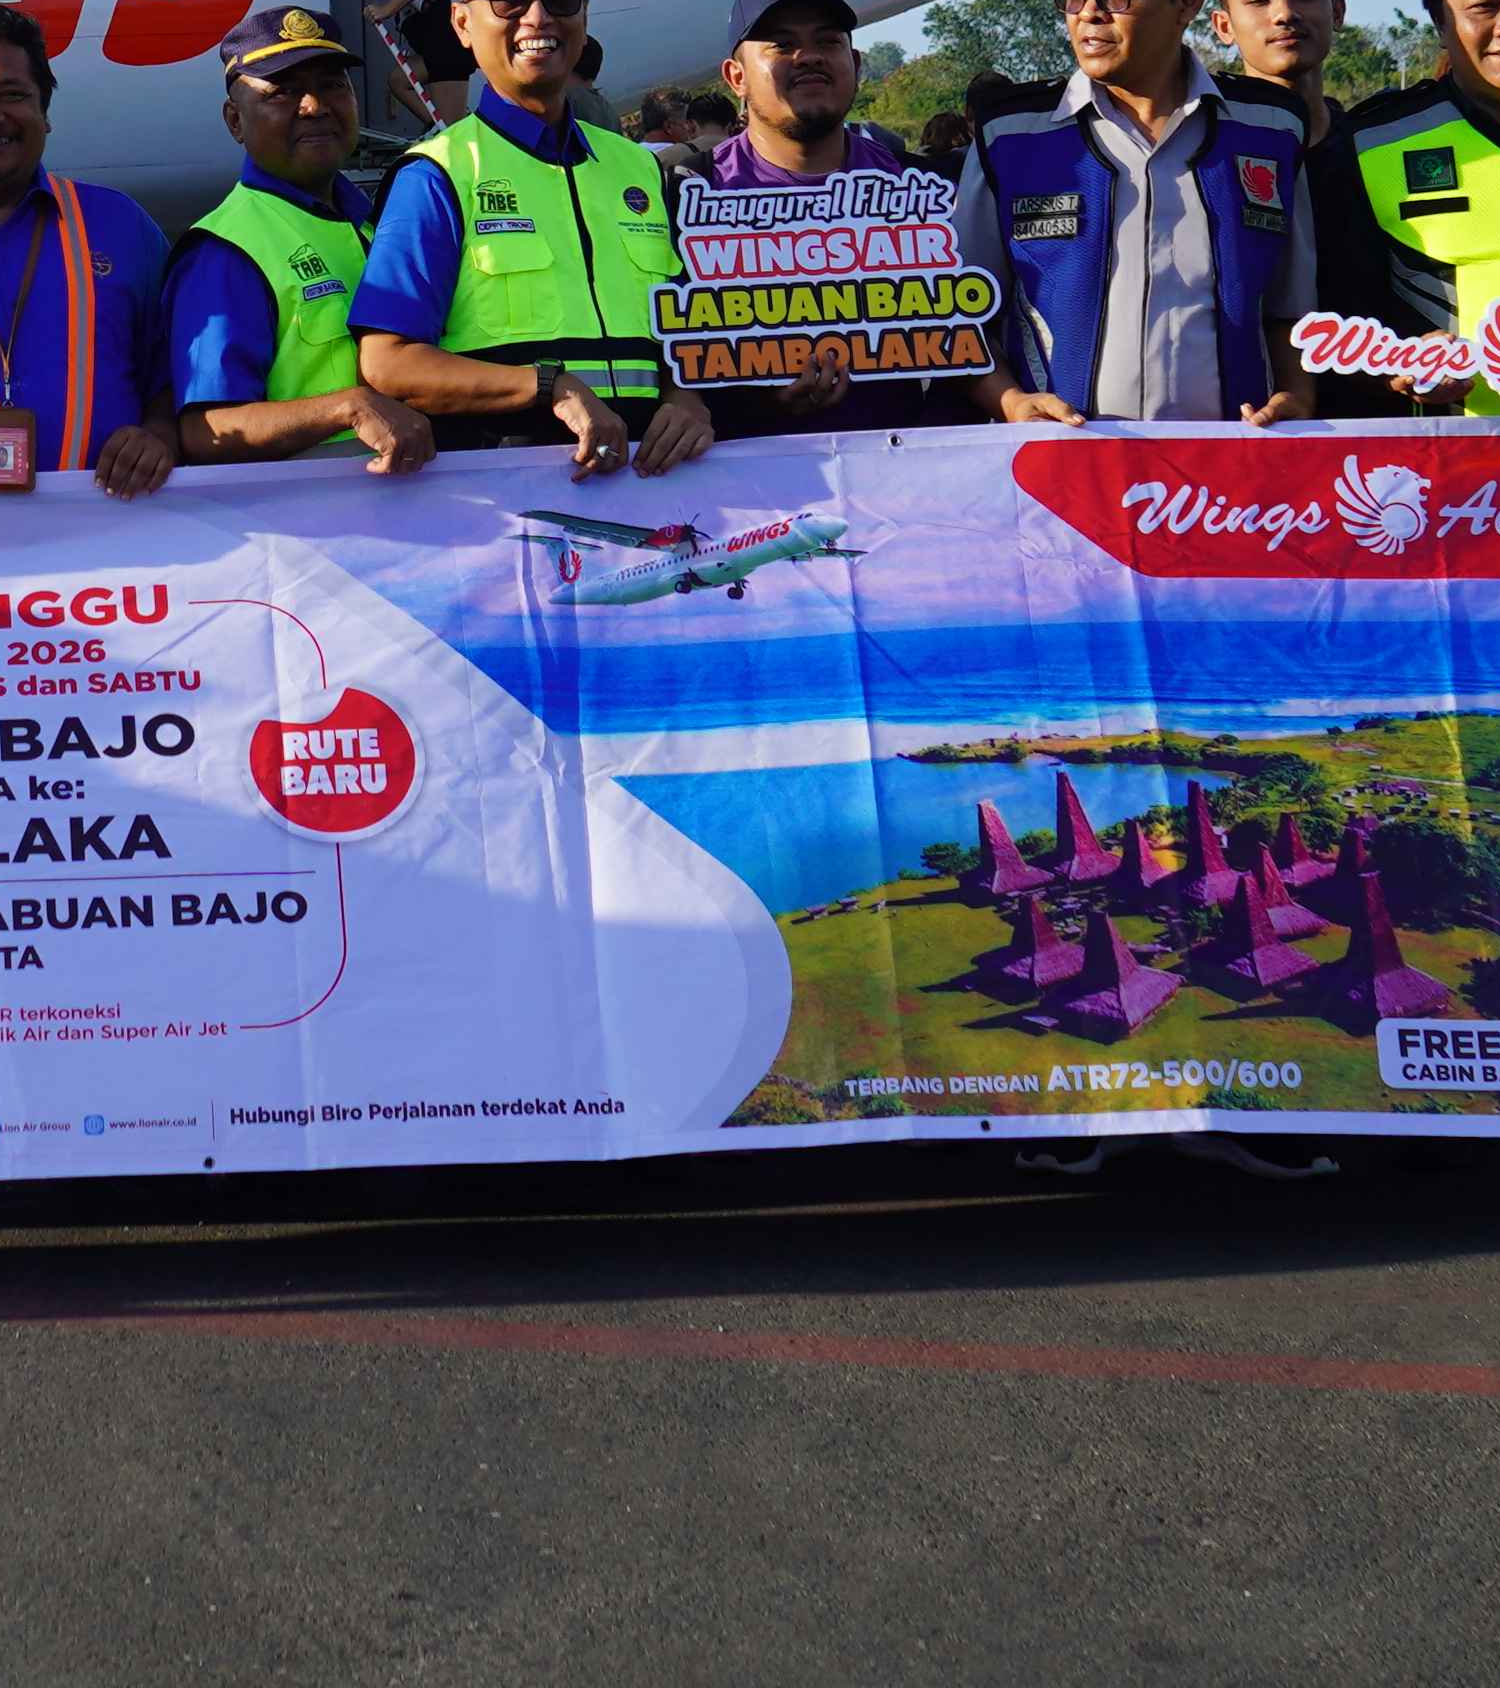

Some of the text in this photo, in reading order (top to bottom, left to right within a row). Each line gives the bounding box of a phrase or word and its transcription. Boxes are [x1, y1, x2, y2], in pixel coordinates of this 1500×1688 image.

[477, 191, 518, 212] TABE
[685, 173, 952, 229] Inaugural Flight
[686, 223, 957, 280] WINGS AIR
[656, 272, 995, 334] LABUAN BAJO
[672, 324, 991, 385] TAMBOLAKA
[1299, 319, 1476, 387] Wings
[1121, 480, 1330, 551] Wings
[726, 517, 794, 553] WINGS
[7, 639, 107, 666] 2026
[17, 673, 77, 696] dan
[87, 669, 201, 694] SABTU
[0, 712, 196, 762] BAJO
[282, 727, 380, 761] RUTE
[28, 775, 85, 803] ke:
[282, 763, 387, 796] BARU
[171, 891, 309, 929] BAJO
[18, 1003, 122, 1022] terkoneksi
[21, 1026, 52, 1043] Air
[56, 1024, 95, 1042] dan
[100, 1022, 161, 1044] Super
[165, 1021, 194, 1038] Air
[198, 1019, 228, 1039] Jet
[845, 1059, 1303, 1098] TERBANG DENGAN ATR72-500/600
[1401, 1063, 1478, 1085] CABIN
[0, 1120, 72, 1135] Lion Air Group
[109, 1116, 197, 1129] www.lionair.co.id
[229, 1097, 626, 1127] Hubungi Biro Perjalanan terdekat Anda
